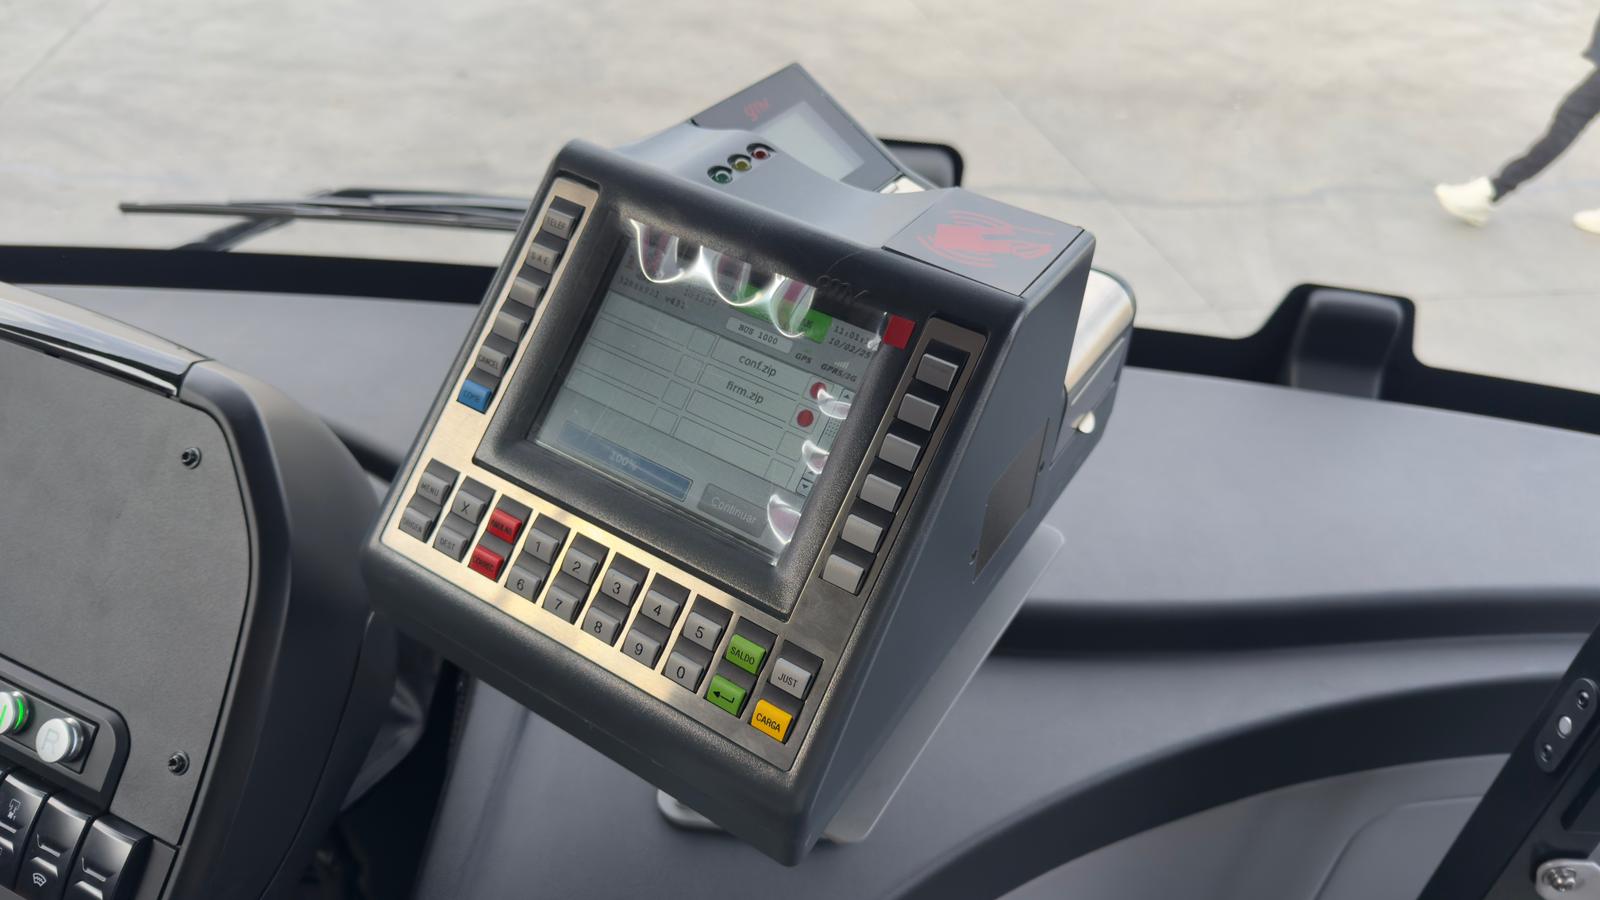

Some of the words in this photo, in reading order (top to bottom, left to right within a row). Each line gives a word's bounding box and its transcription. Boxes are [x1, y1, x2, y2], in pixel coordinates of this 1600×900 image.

[795, 352, 813, 364] GPS
[738, 355, 777, 377] conf.zip
[726, 381, 764, 404] firm.zip
[421, 481, 440, 498] MENU
[460, 501, 469, 515] X
[711, 496, 757, 524] Continuar
[572, 561, 581, 573] 2
[516, 578, 525, 591] 6
[612, 582, 621, 594] 3
[554, 599, 563, 611] 7
[653, 604, 662, 616] 4
[593, 620, 602, 633] 8
[695, 626, 704, 639] 5
[634, 643, 643, 656] 9
[730, 646, 755, 665] SALDO
[676, 665, 685, 679] 0
[778, 672, 798, 688] JUST
[756, 713, 781, 732] CARGA
[42, 728, 59, 754] R
